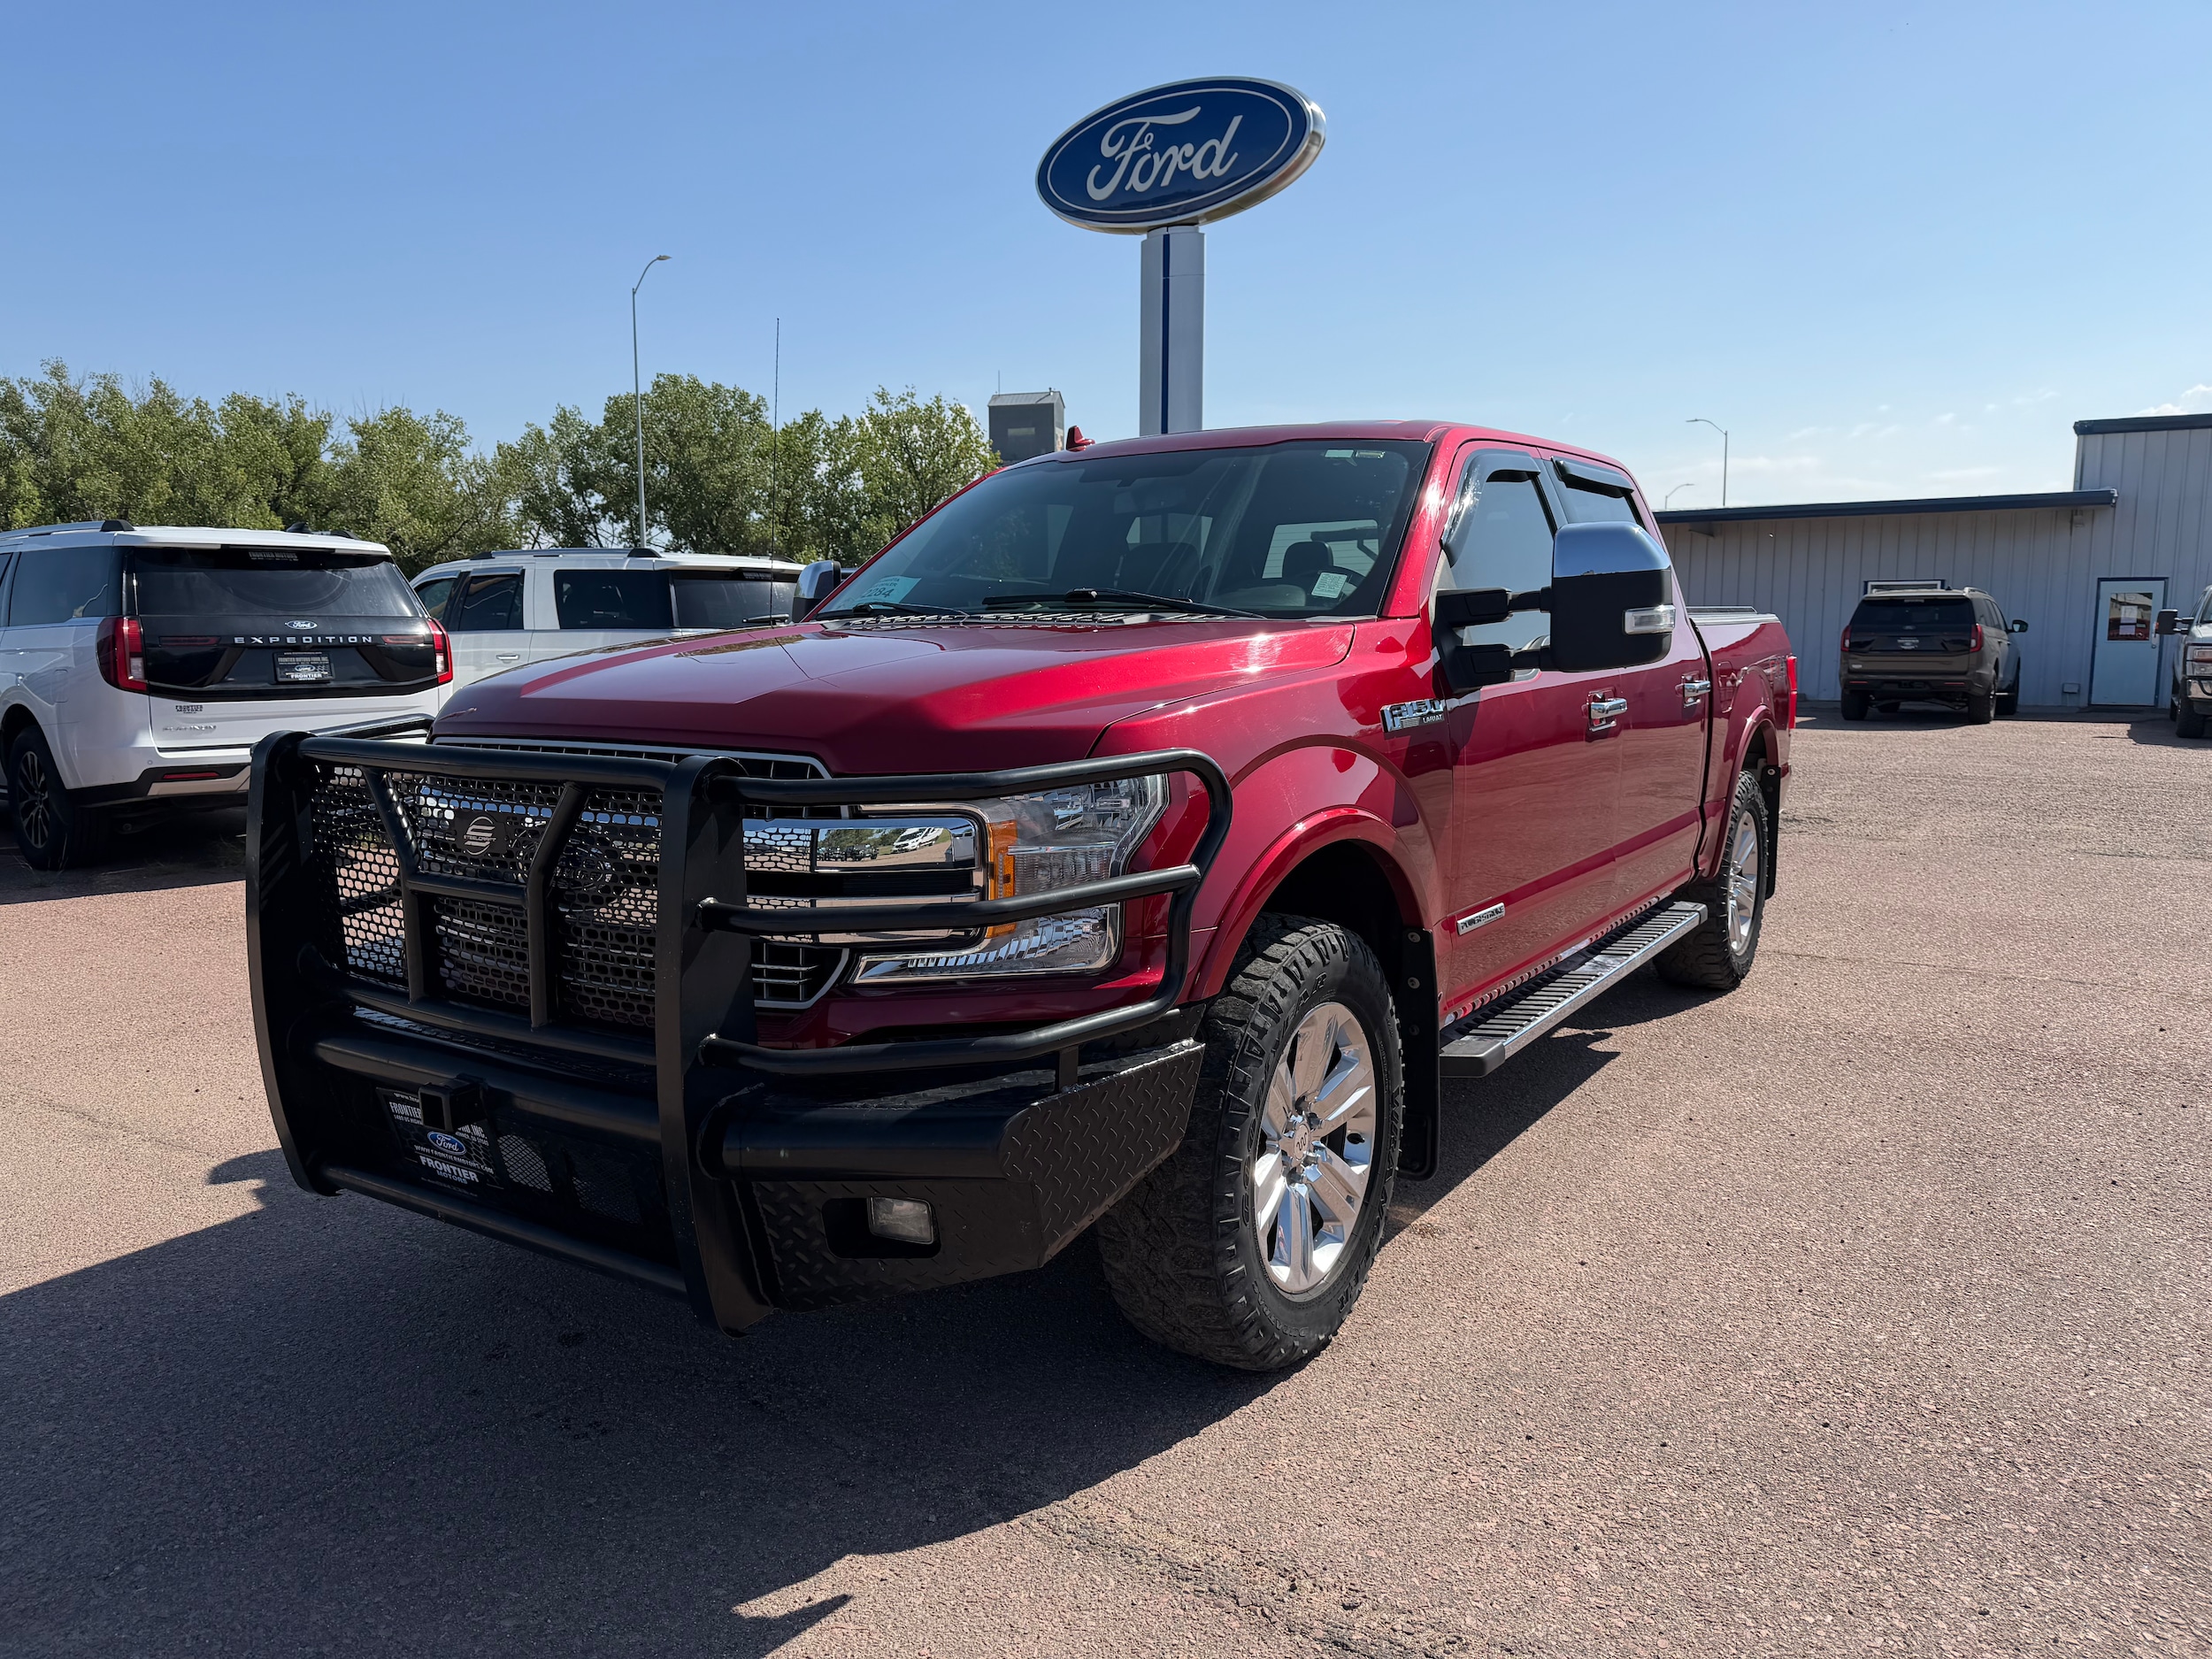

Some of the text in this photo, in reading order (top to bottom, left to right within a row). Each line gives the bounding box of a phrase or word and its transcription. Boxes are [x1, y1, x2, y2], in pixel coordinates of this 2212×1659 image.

[1086, 105, 1243, 201] Ford
[1423, 714, 1444, 724] LARIAT
[436, 1133, 459, 1152] Ford
[419, 1155, 479, 1183] FRONTIER
[436, 1170, 468, 1185] MOTORS
